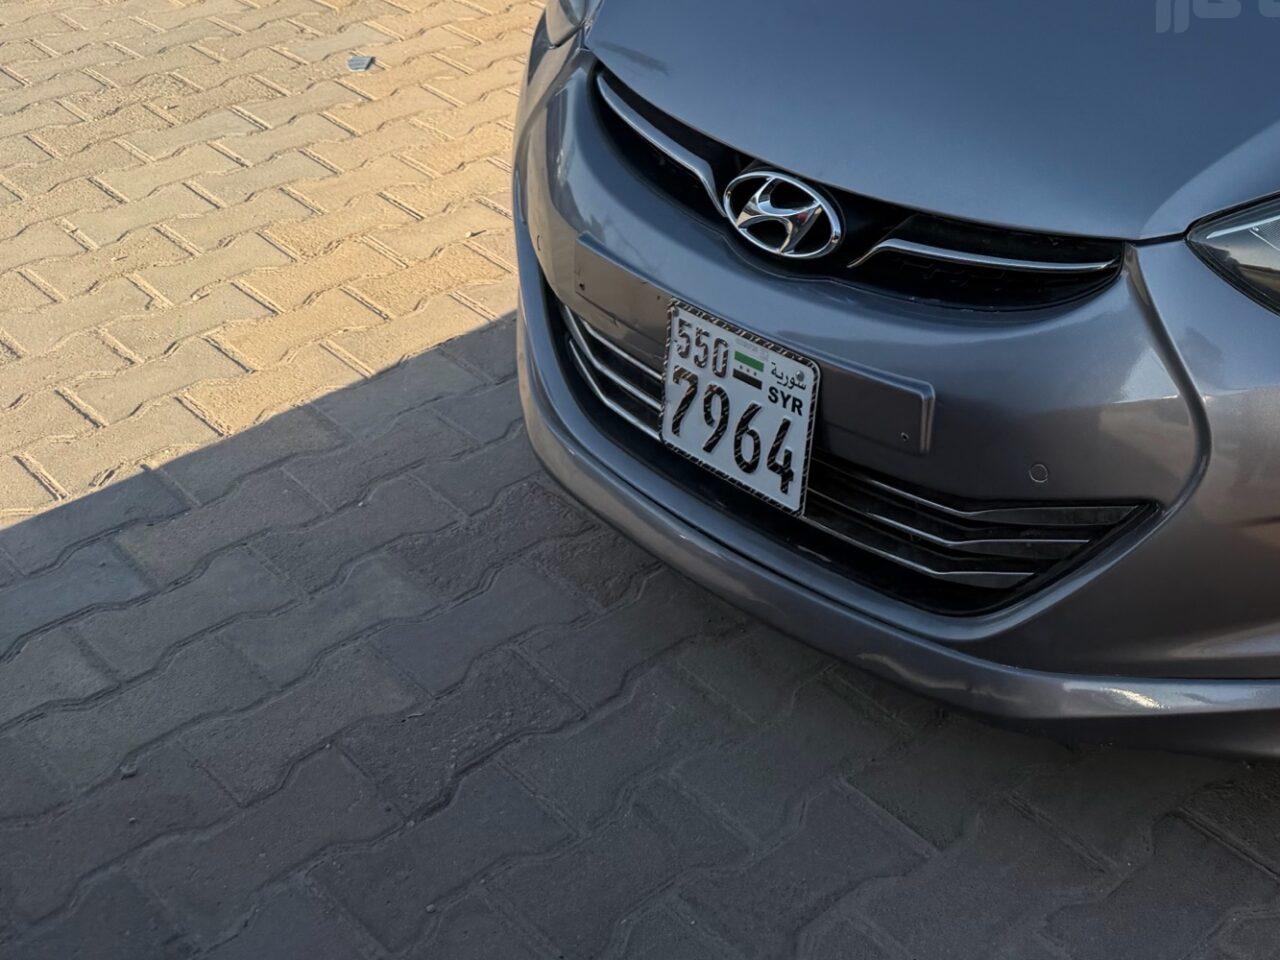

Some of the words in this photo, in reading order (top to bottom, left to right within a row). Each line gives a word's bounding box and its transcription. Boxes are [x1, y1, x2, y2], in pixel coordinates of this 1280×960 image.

[675, 318, 729, 379] 550
[769, 360, 807, 391] سورية
[767, 385, 803, 417] SYR
[671, 364, 795, 495] 7964
